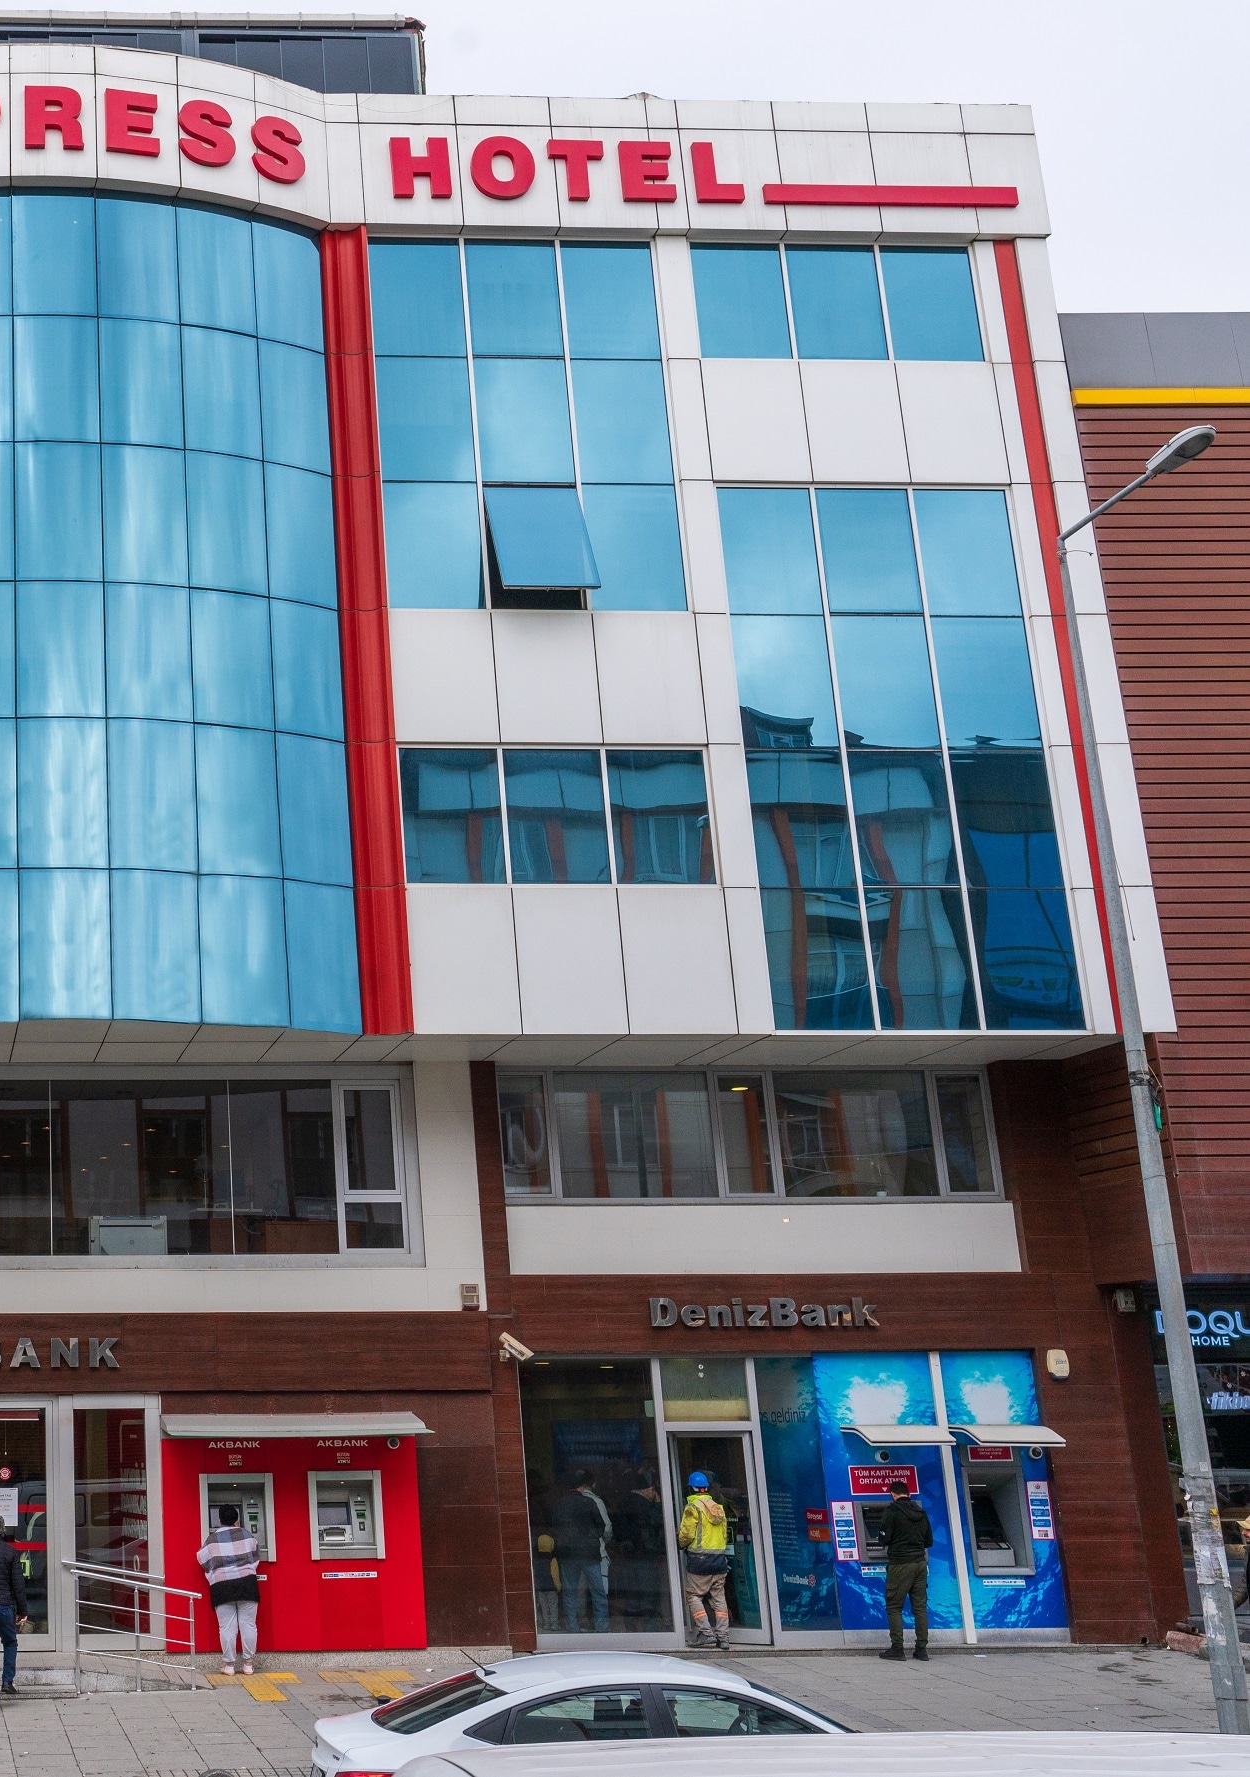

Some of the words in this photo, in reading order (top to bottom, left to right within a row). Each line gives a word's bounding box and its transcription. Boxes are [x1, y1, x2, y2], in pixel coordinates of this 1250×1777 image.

[389, 135, 745, 204] HOTEL
[649, 1297, 880, 1327] DenizBank
[1192, 1336, 1230, 1346] HOME
[770, 1408, 807, 1426] geldiniz
[208, 1441, 261, 1449] AKBANK
[317, 1439, 369, 1447] AKBANK
[854, 1469, 870, 1477] TÜM
